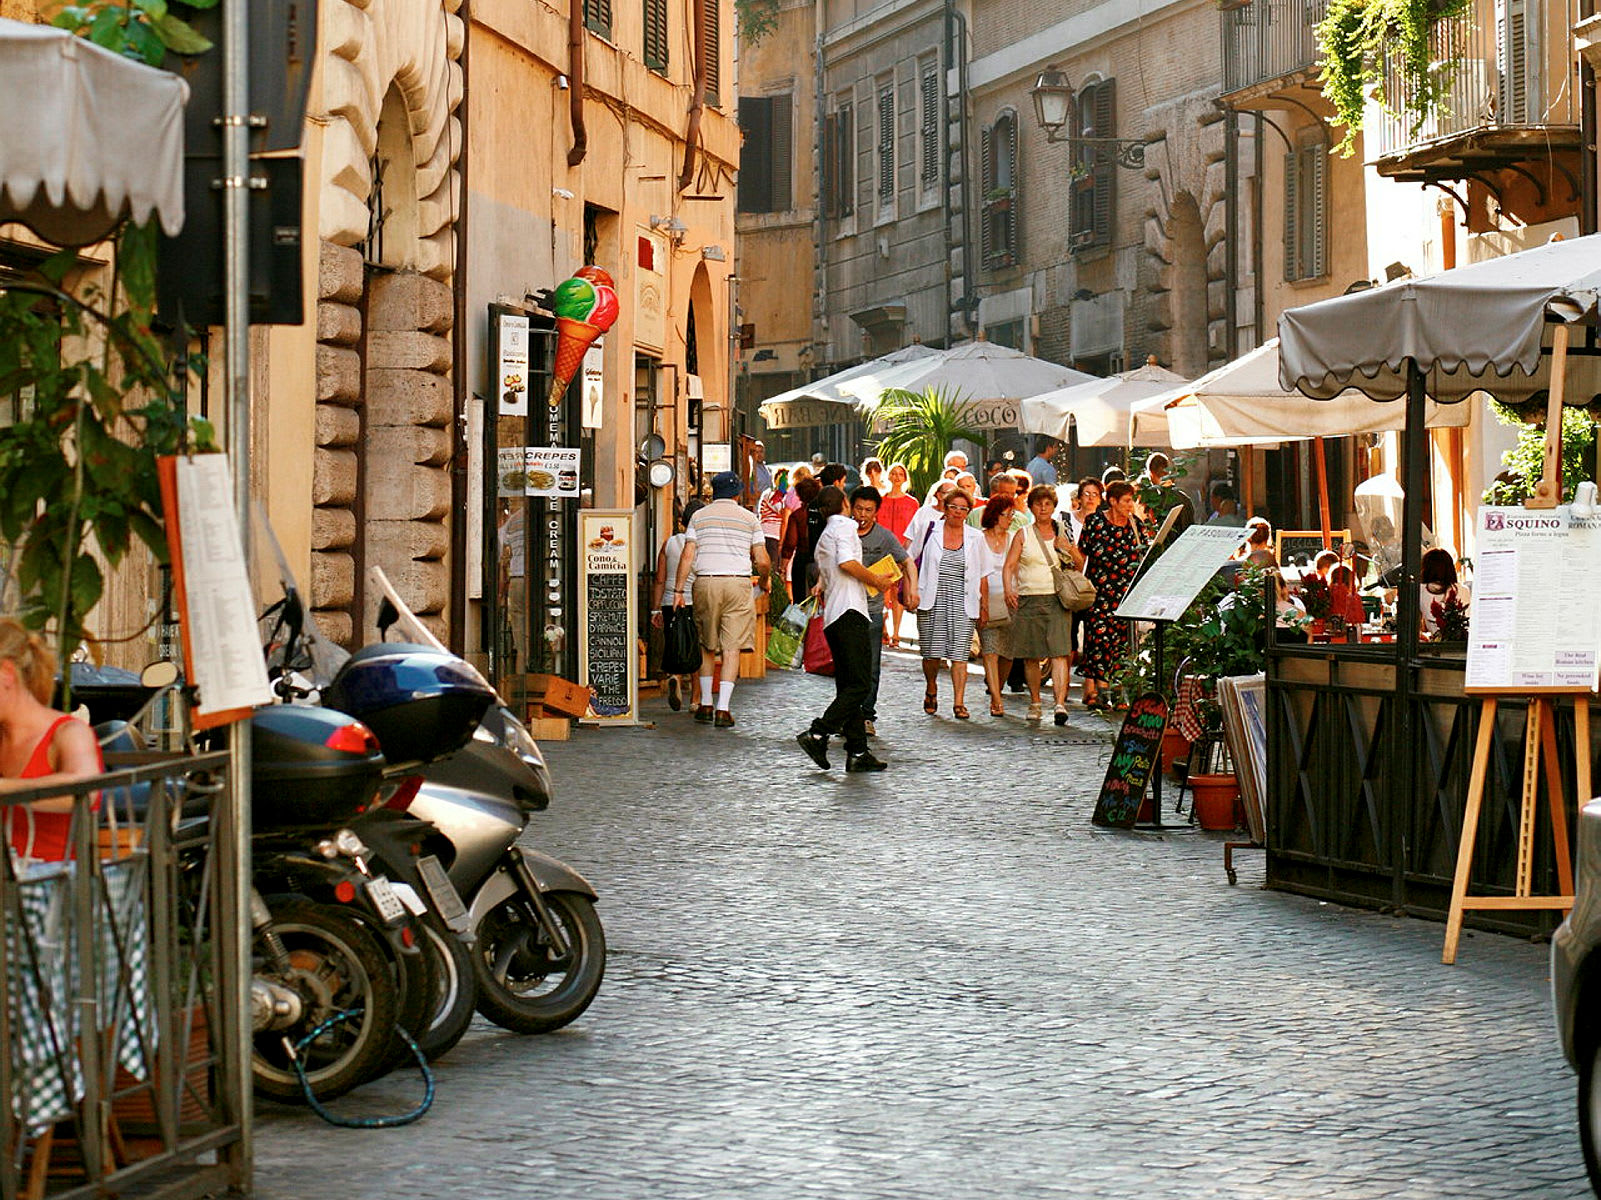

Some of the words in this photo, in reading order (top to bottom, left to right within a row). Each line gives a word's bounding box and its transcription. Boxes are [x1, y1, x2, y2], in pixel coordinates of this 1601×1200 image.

[549, 405, 559, 449] OMEMA
[524, 451, 577, 461] CREPES
[1486, 519, 1561, 530] PASQUINO
[1568, 522, 1601, 530] ROMAN
[549, 520, 559, 568] CREAM
[588, 554, 612, 563] Cono
[588, 562, 627, 570] Camicia
[588, 611, 627, 622] SPREMUTE
[588, 636, 626, 646] CANNOLI
[588, 661, 626, 673] CREPES
[591, 673, 620, 685] VARIE
[601, 685, 621, 695] THE
